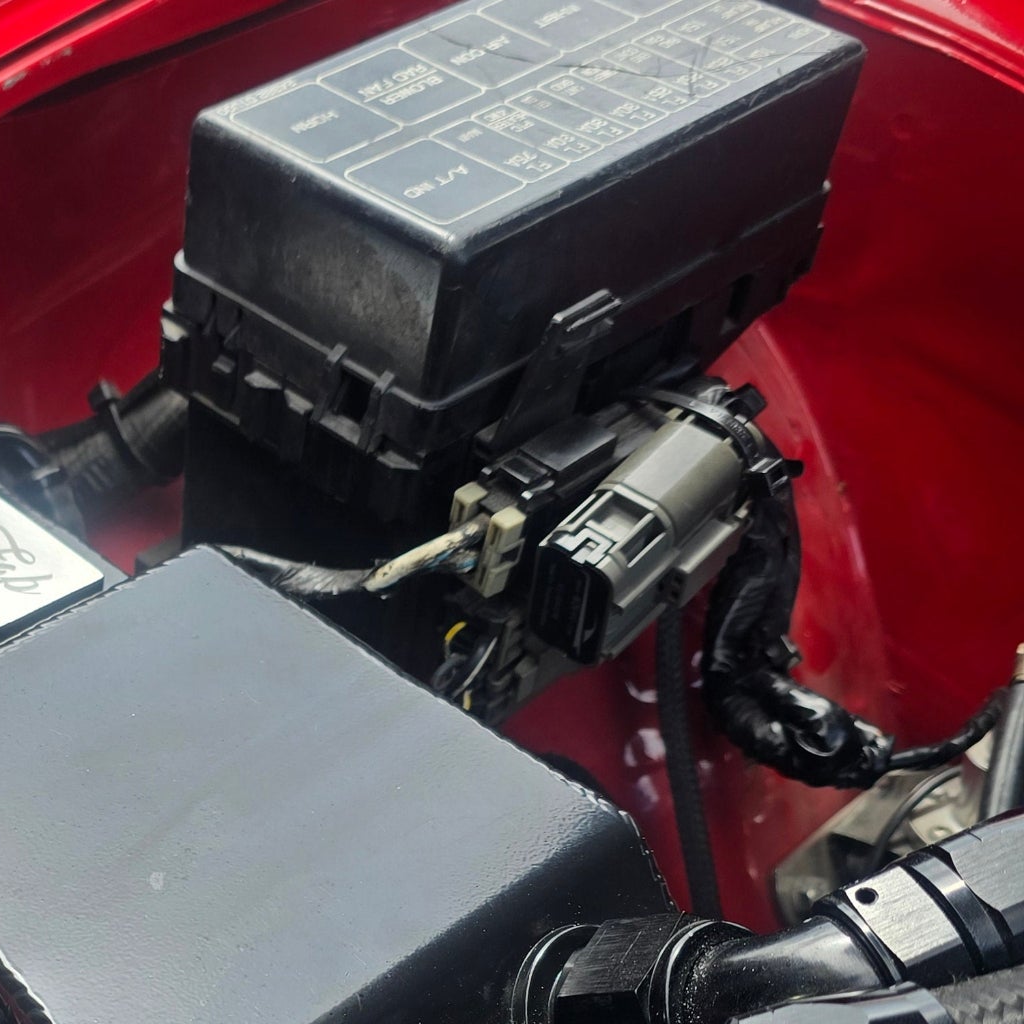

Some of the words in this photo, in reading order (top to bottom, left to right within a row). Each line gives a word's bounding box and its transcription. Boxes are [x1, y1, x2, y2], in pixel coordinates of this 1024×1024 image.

[482, 36, 509, 49] AIR
[447, 48, 484, 65] CON
[390, 64, 427, 80] RAD
[356, 79, 393, 96] FAN
[379, 75, 443, 104] BLOWER
[661, 96, 687, 107] FL
[287, 110, 341, 133] HORN
[630, 111, 655, 122] FL
[597, 126, 623, 138] FL
[563, 143, 590, 155] FL
[503, 151, 536, 166] 75A
[433, 164, 470, 185] A/T
[525, 161, 551, 173] FL
[402, 181, 433, 198] IND
